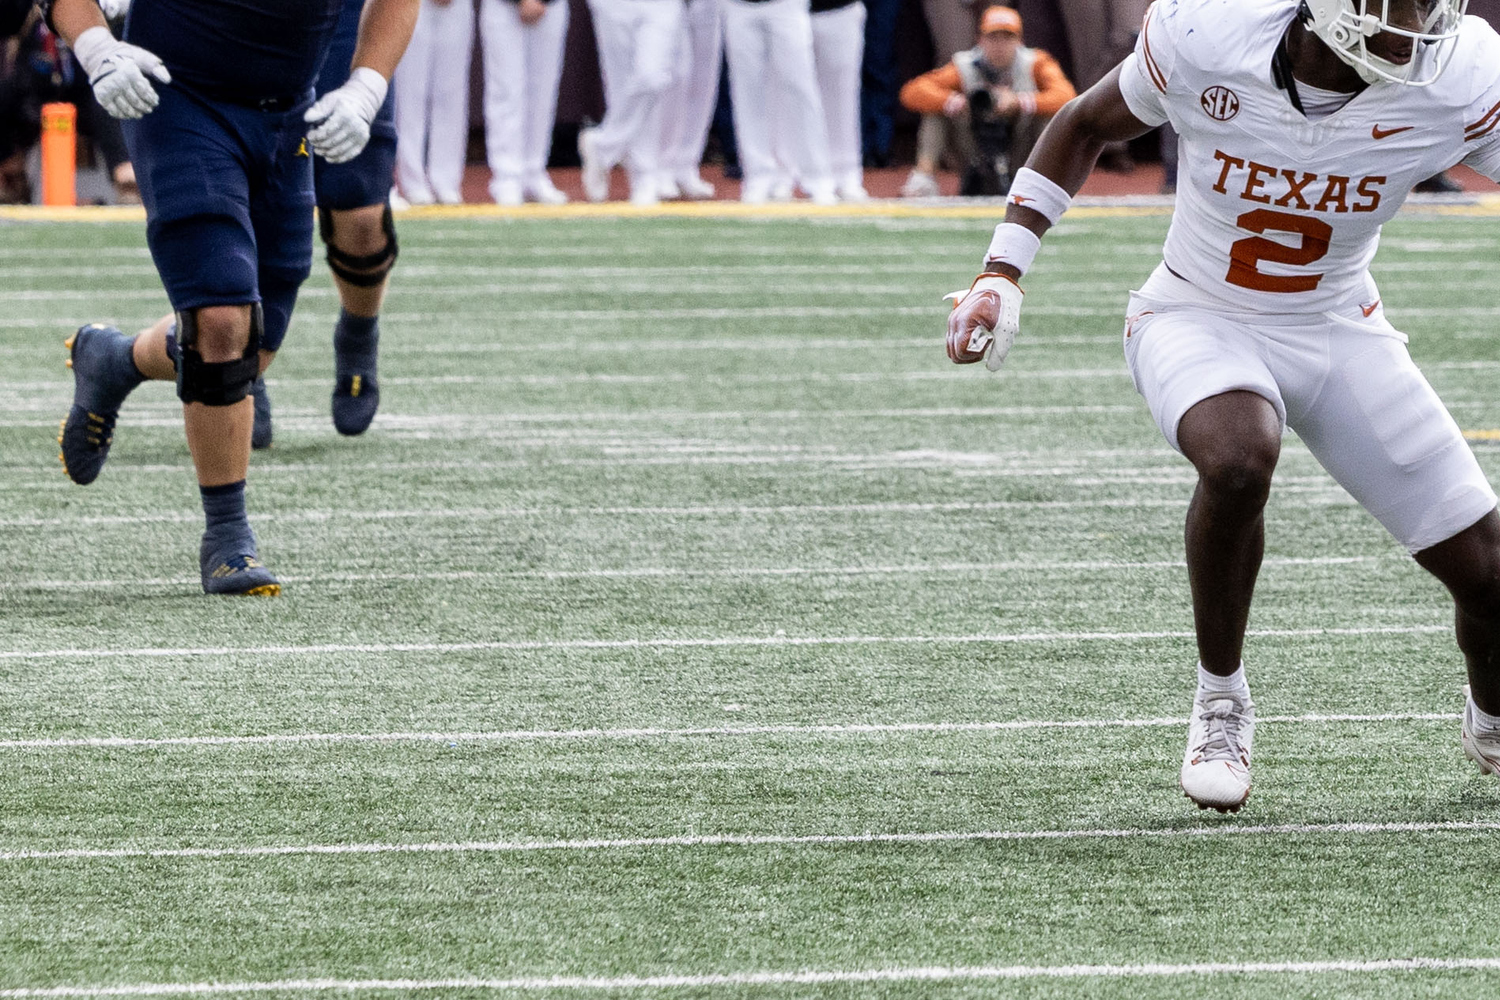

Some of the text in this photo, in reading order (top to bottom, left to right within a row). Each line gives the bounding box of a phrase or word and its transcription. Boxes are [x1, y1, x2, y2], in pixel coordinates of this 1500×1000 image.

[1203, 88, 1237, 118] SEC
[1211, 148, 1388, 214] TEXAS
[1224, 207, 1334, 294] 2
